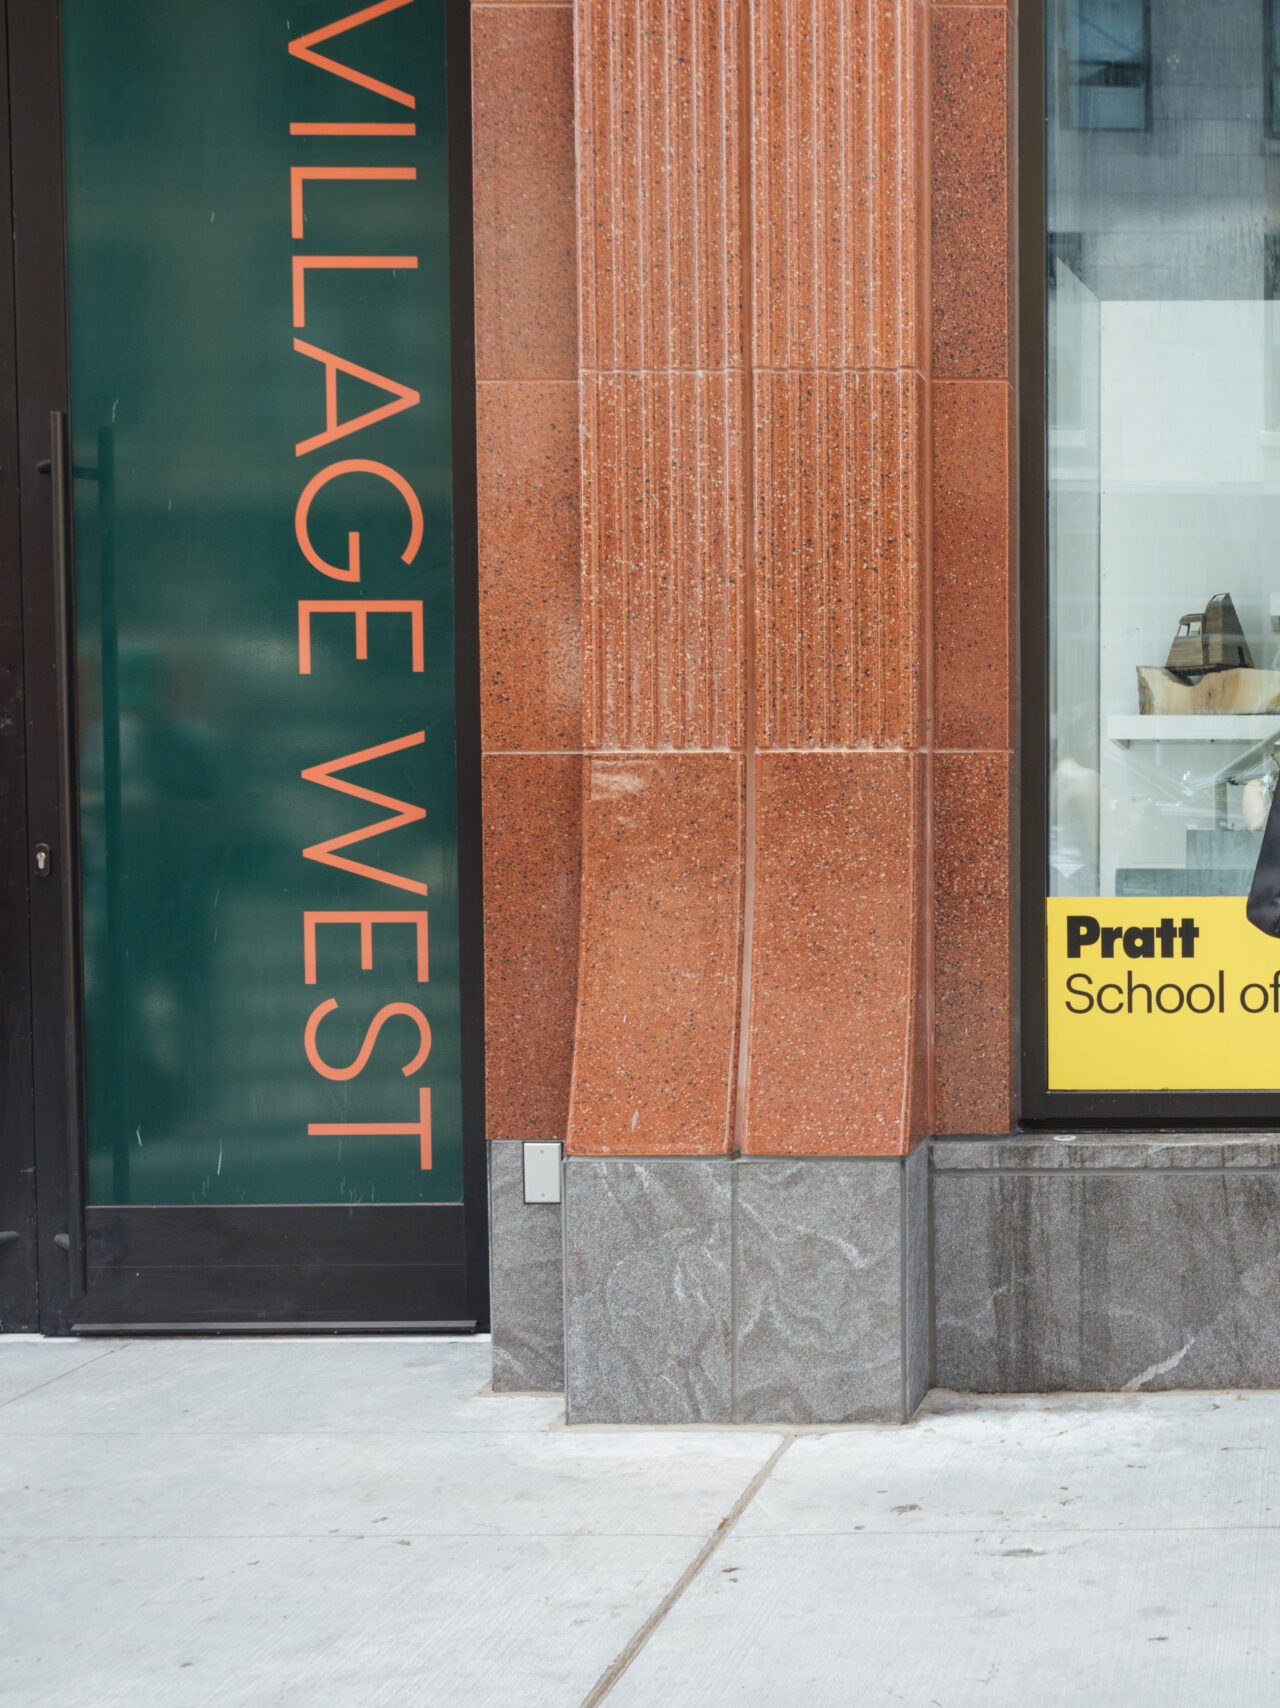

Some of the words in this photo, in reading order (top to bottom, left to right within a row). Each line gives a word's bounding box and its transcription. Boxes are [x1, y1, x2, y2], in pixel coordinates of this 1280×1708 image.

[287, 0, 425, 675] VILLAGE
[300, 730, 432, 1171] WEST
[1065, 970, 1225, 1014] School
[1066, 915, 1200, 959] Pratt
